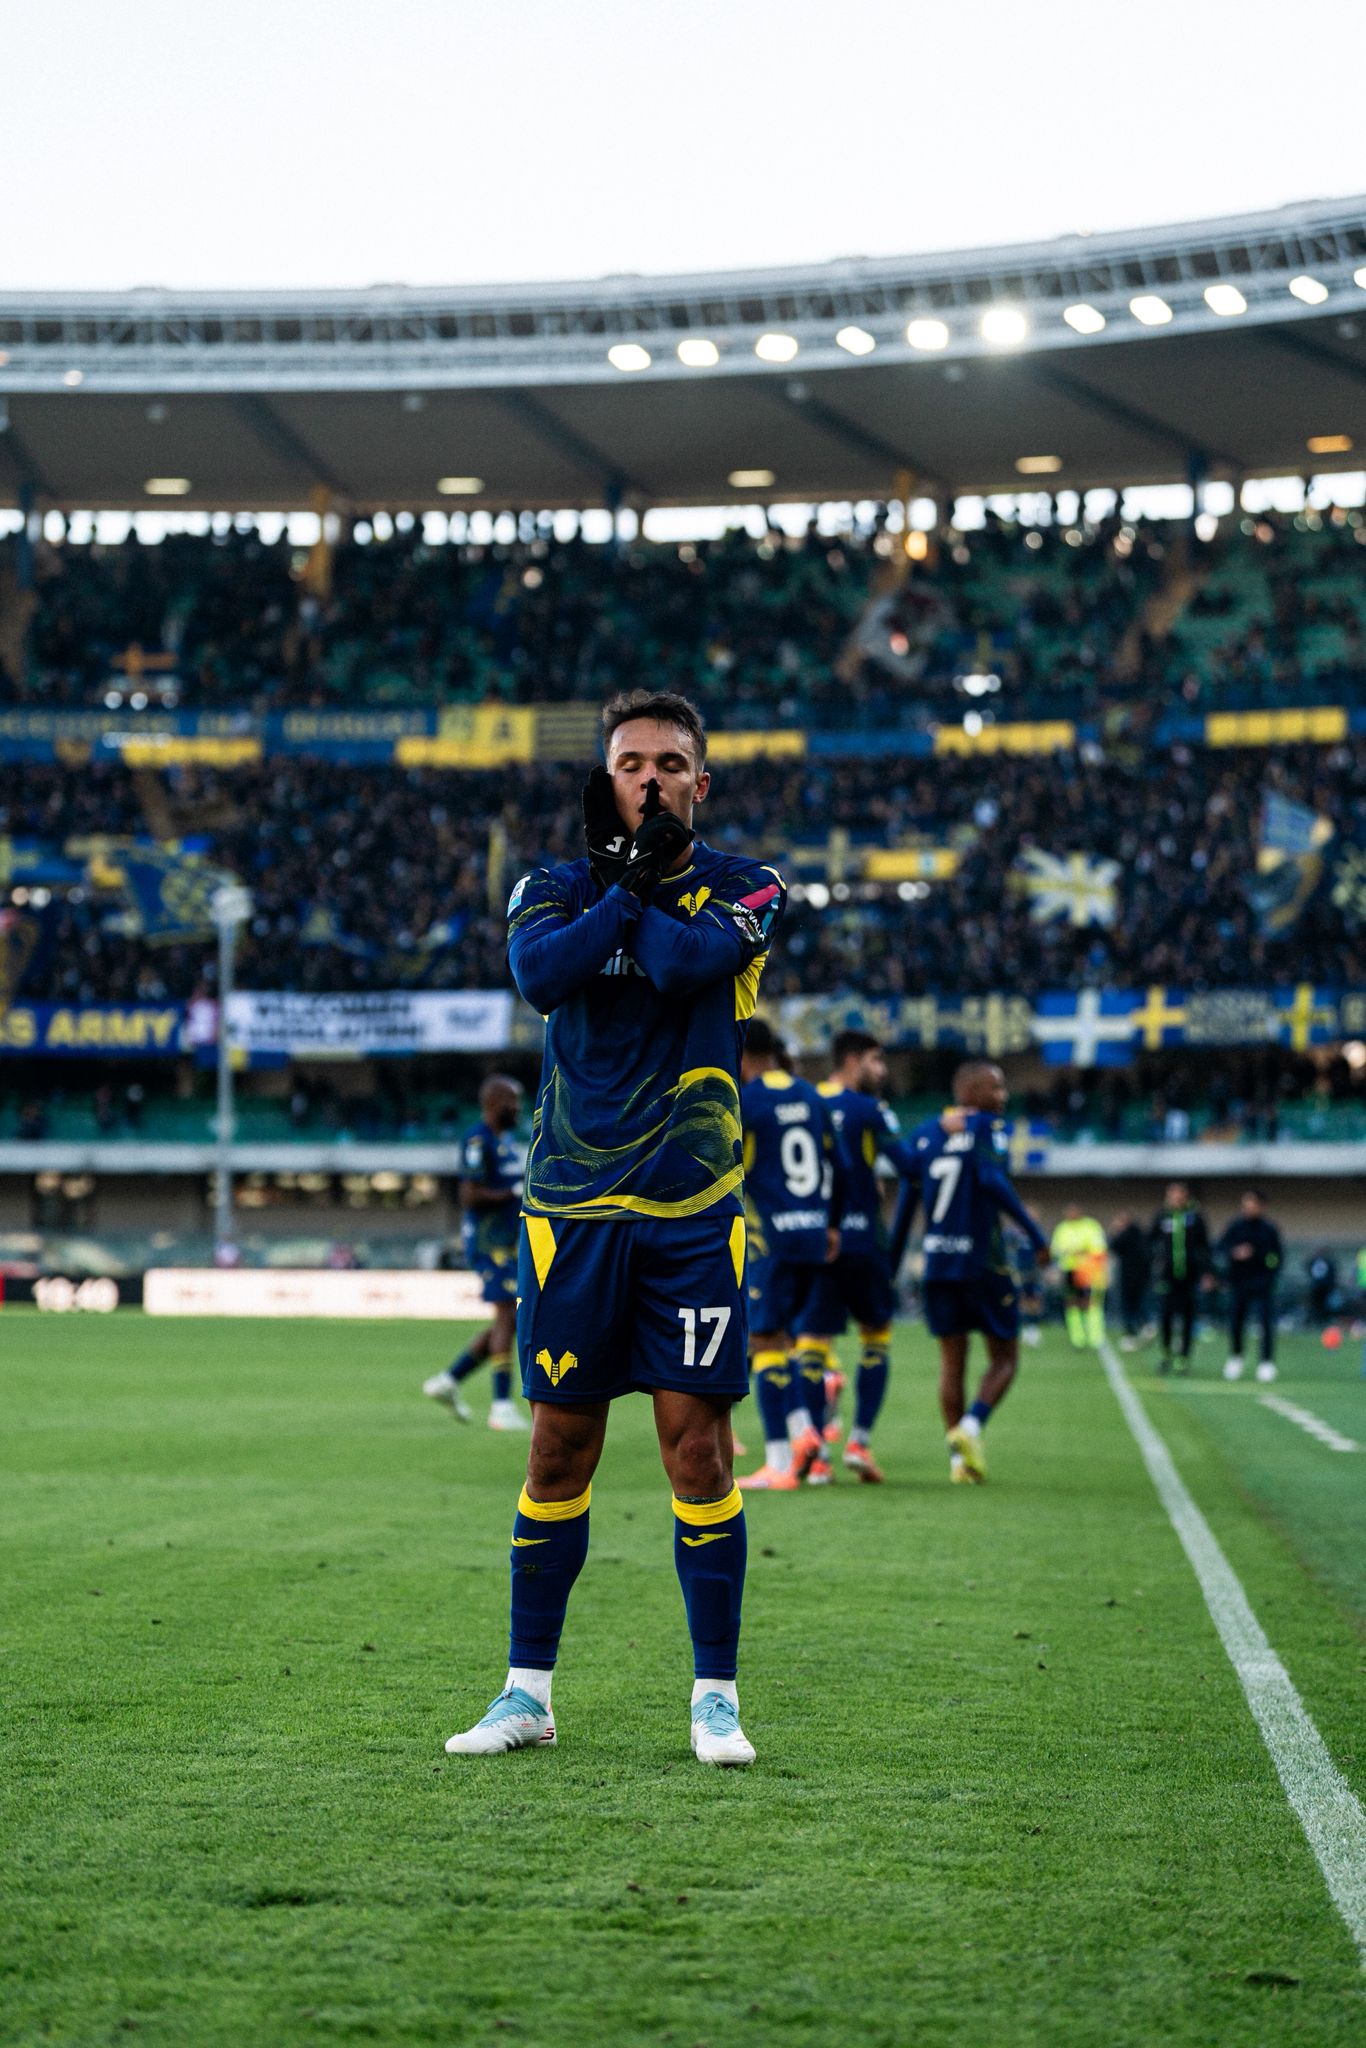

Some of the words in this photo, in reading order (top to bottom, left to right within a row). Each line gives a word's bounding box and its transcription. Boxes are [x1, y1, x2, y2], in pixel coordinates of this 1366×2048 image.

[47, 1010, 177, 1047] ARMY
[781, 1126, 820, 1198] 9
[929, 1155, 963, 1224] 7
[678, 1307, 731, 1367] 17
